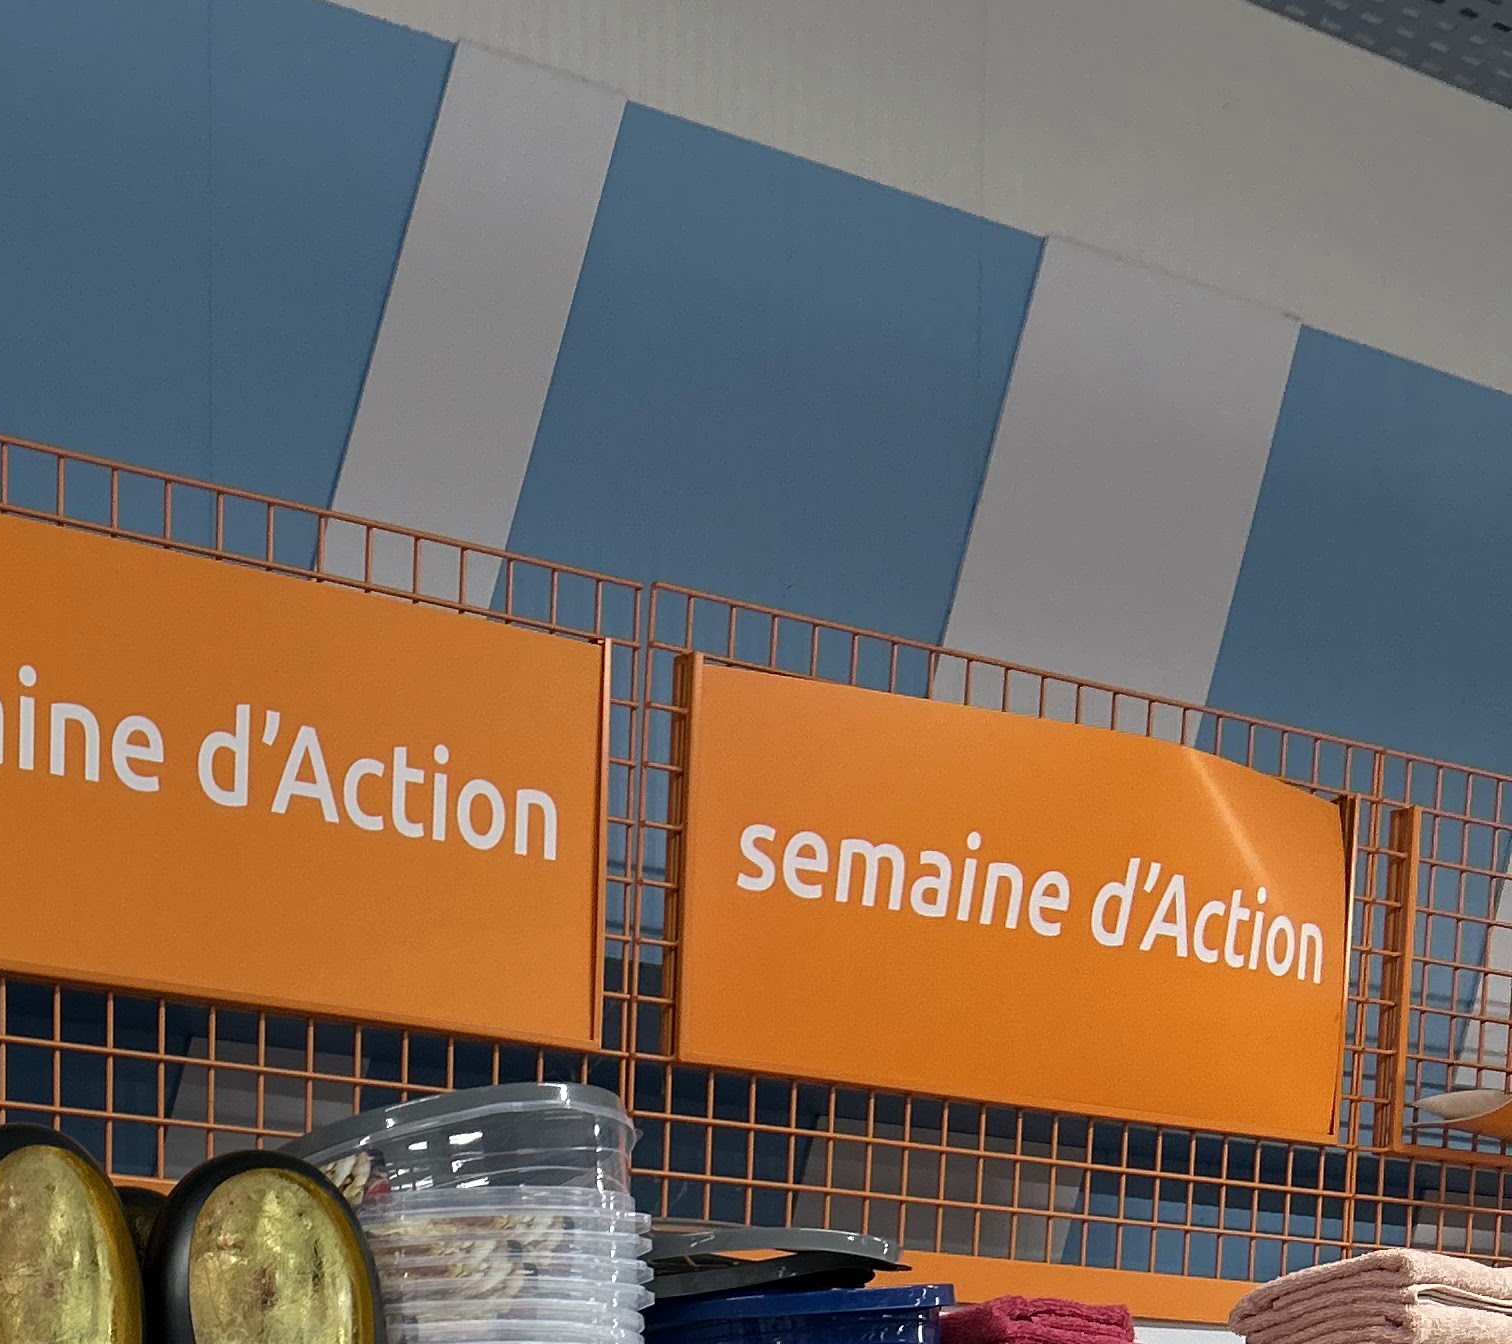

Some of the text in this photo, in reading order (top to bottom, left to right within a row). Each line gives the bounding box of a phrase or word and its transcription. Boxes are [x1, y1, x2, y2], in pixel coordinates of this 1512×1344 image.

[198, 703, 558, 861] d’Action
[737, 823, 1324, 984] semaine d’Action
